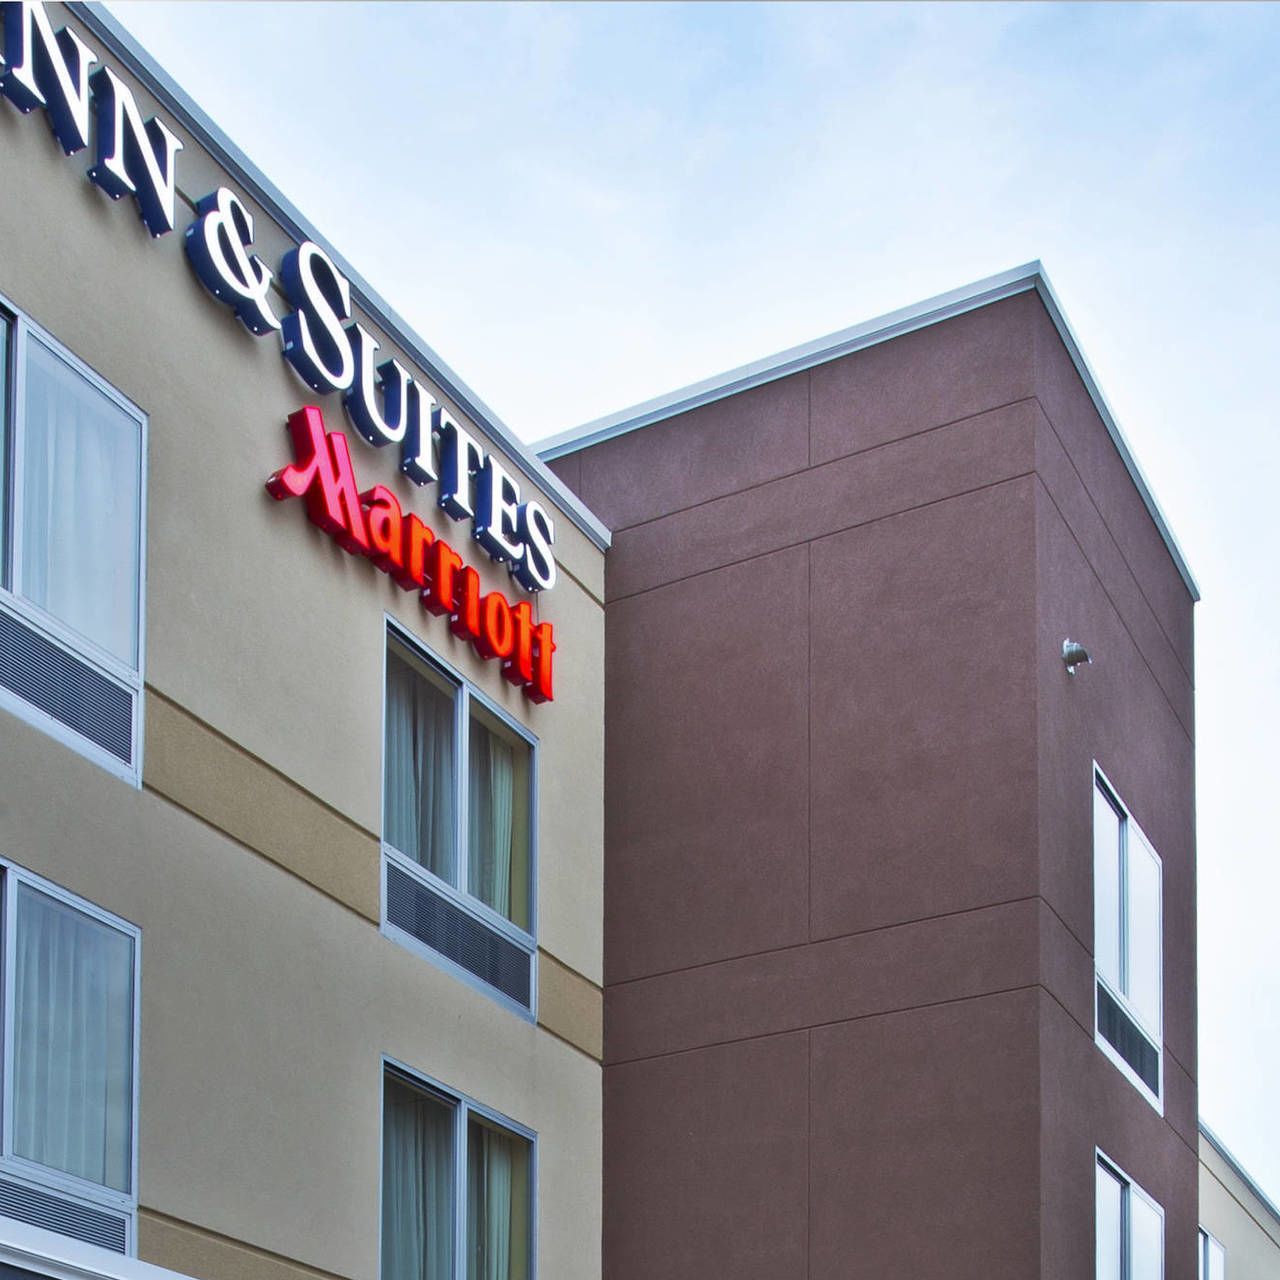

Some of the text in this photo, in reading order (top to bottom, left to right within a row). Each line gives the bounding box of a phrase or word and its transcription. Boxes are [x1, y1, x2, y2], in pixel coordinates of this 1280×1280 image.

[190, 187, 280, 333] &
[286, 241, 558, 592] SUITES
[270, 406, 557, 703] Marriott
